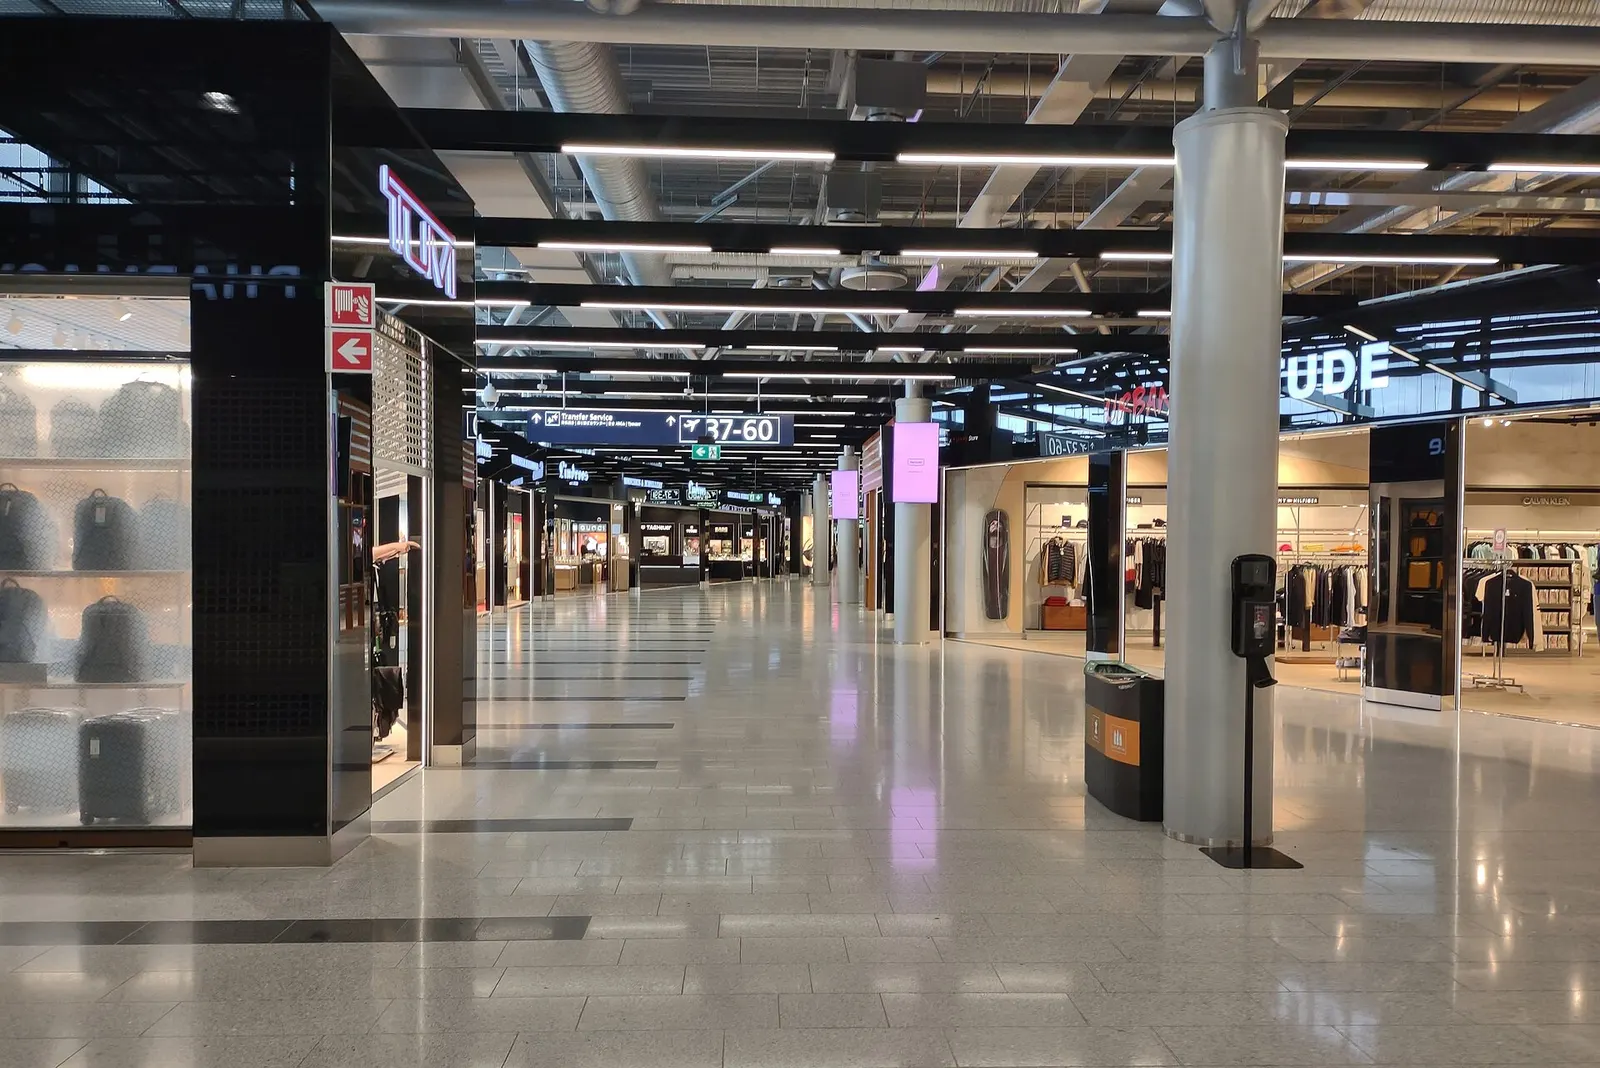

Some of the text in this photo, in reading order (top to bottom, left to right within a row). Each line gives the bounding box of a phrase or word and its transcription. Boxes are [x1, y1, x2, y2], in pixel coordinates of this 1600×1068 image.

[1281, 341, 1390, 399] UDE
[561, 412, 613, 421] Transfer Service
[706, 418, 773, 441] 37-60
[1523, 497, 1571, 505] CALVIN KLEIN
